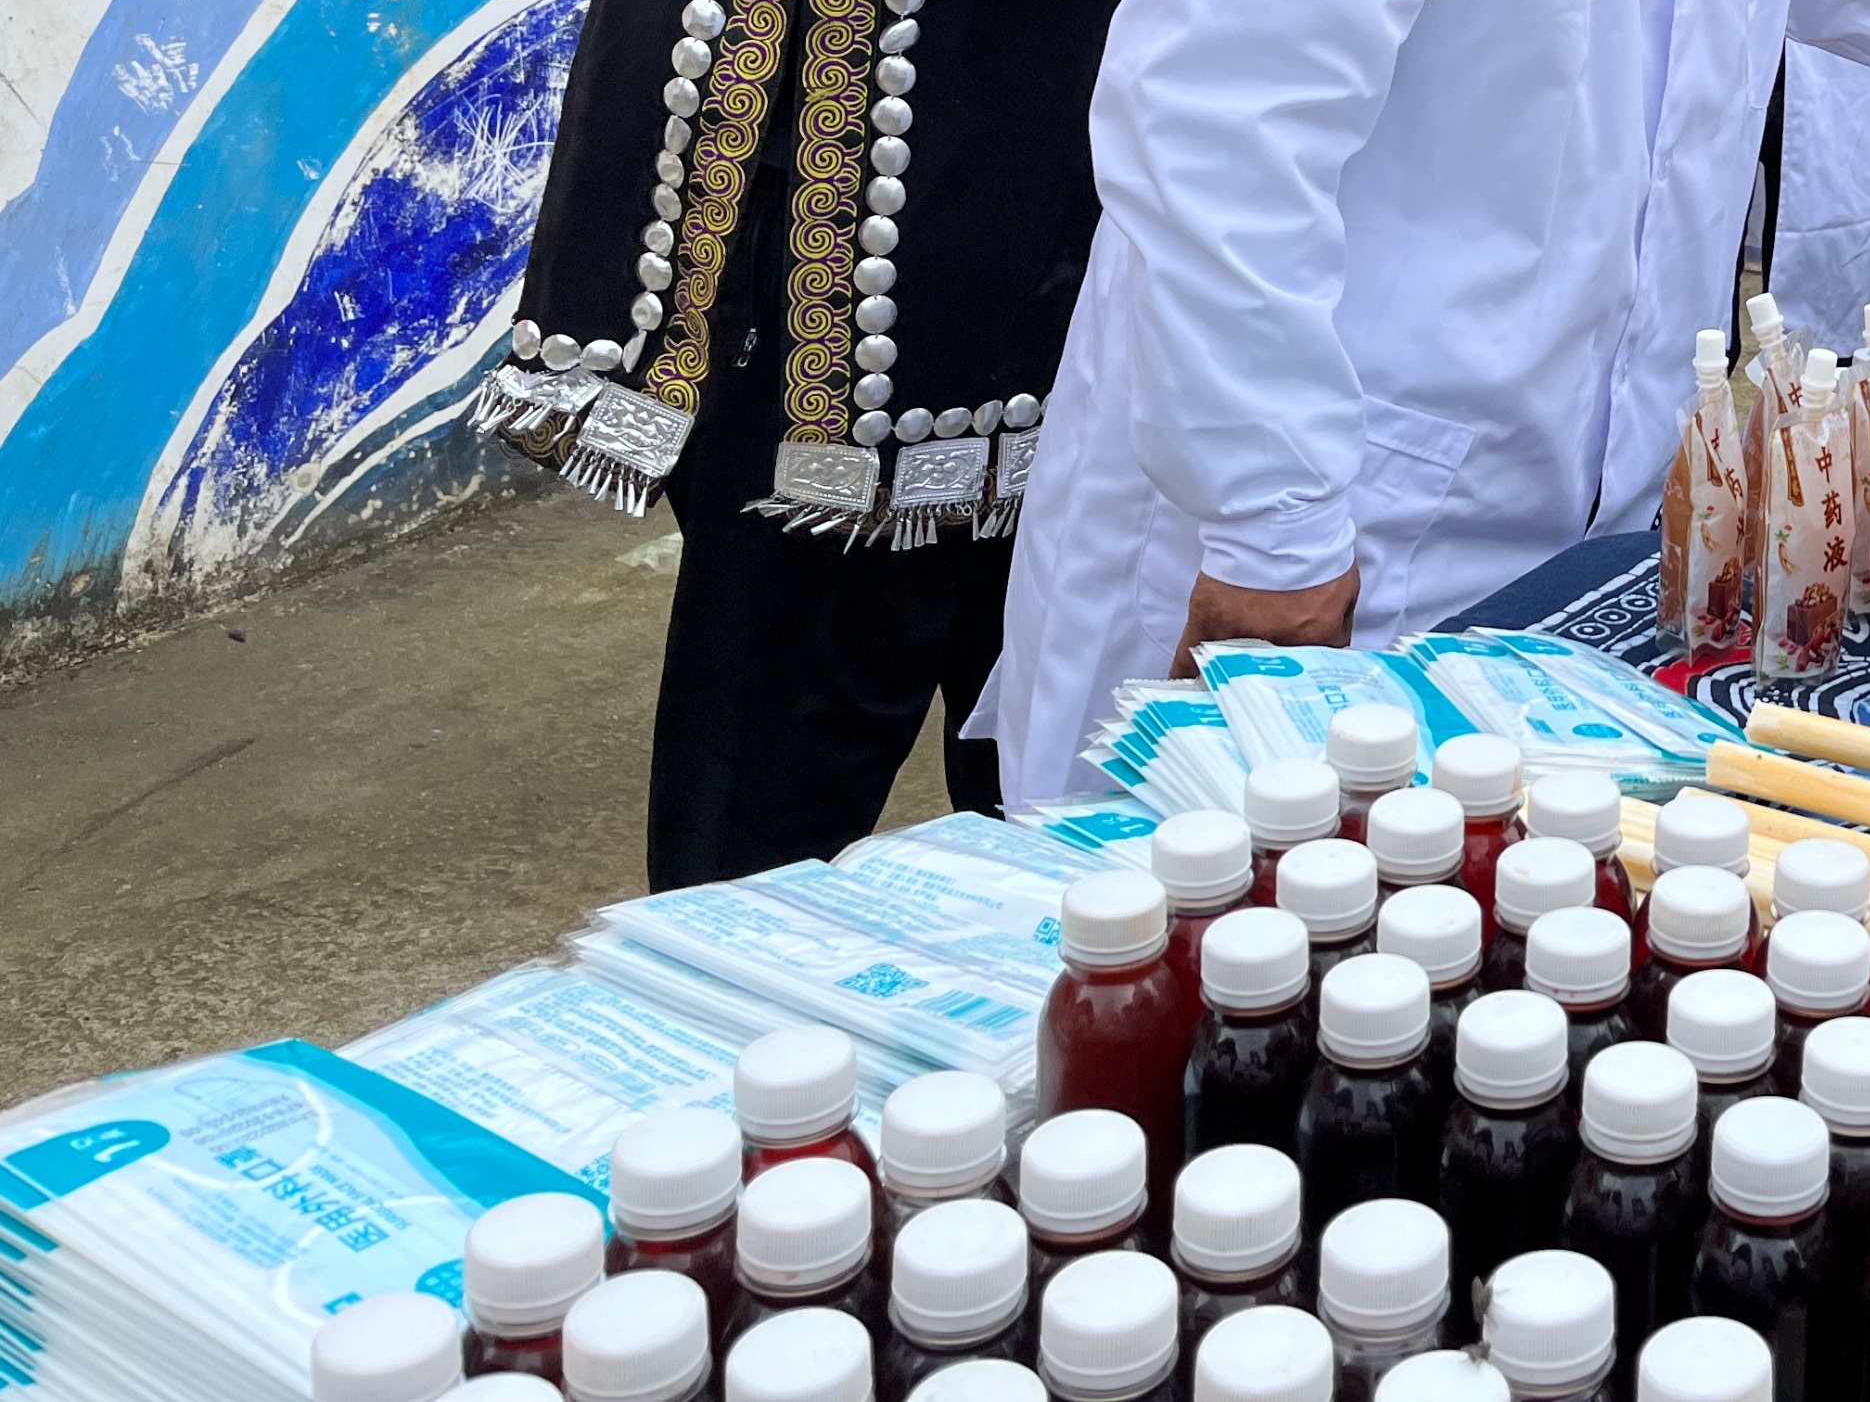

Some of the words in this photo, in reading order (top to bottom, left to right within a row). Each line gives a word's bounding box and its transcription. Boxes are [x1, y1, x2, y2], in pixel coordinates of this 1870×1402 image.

[1815, 446, 1848, 573] 中药液
[214, 1144, 392, 1254] 医用外科口罩
